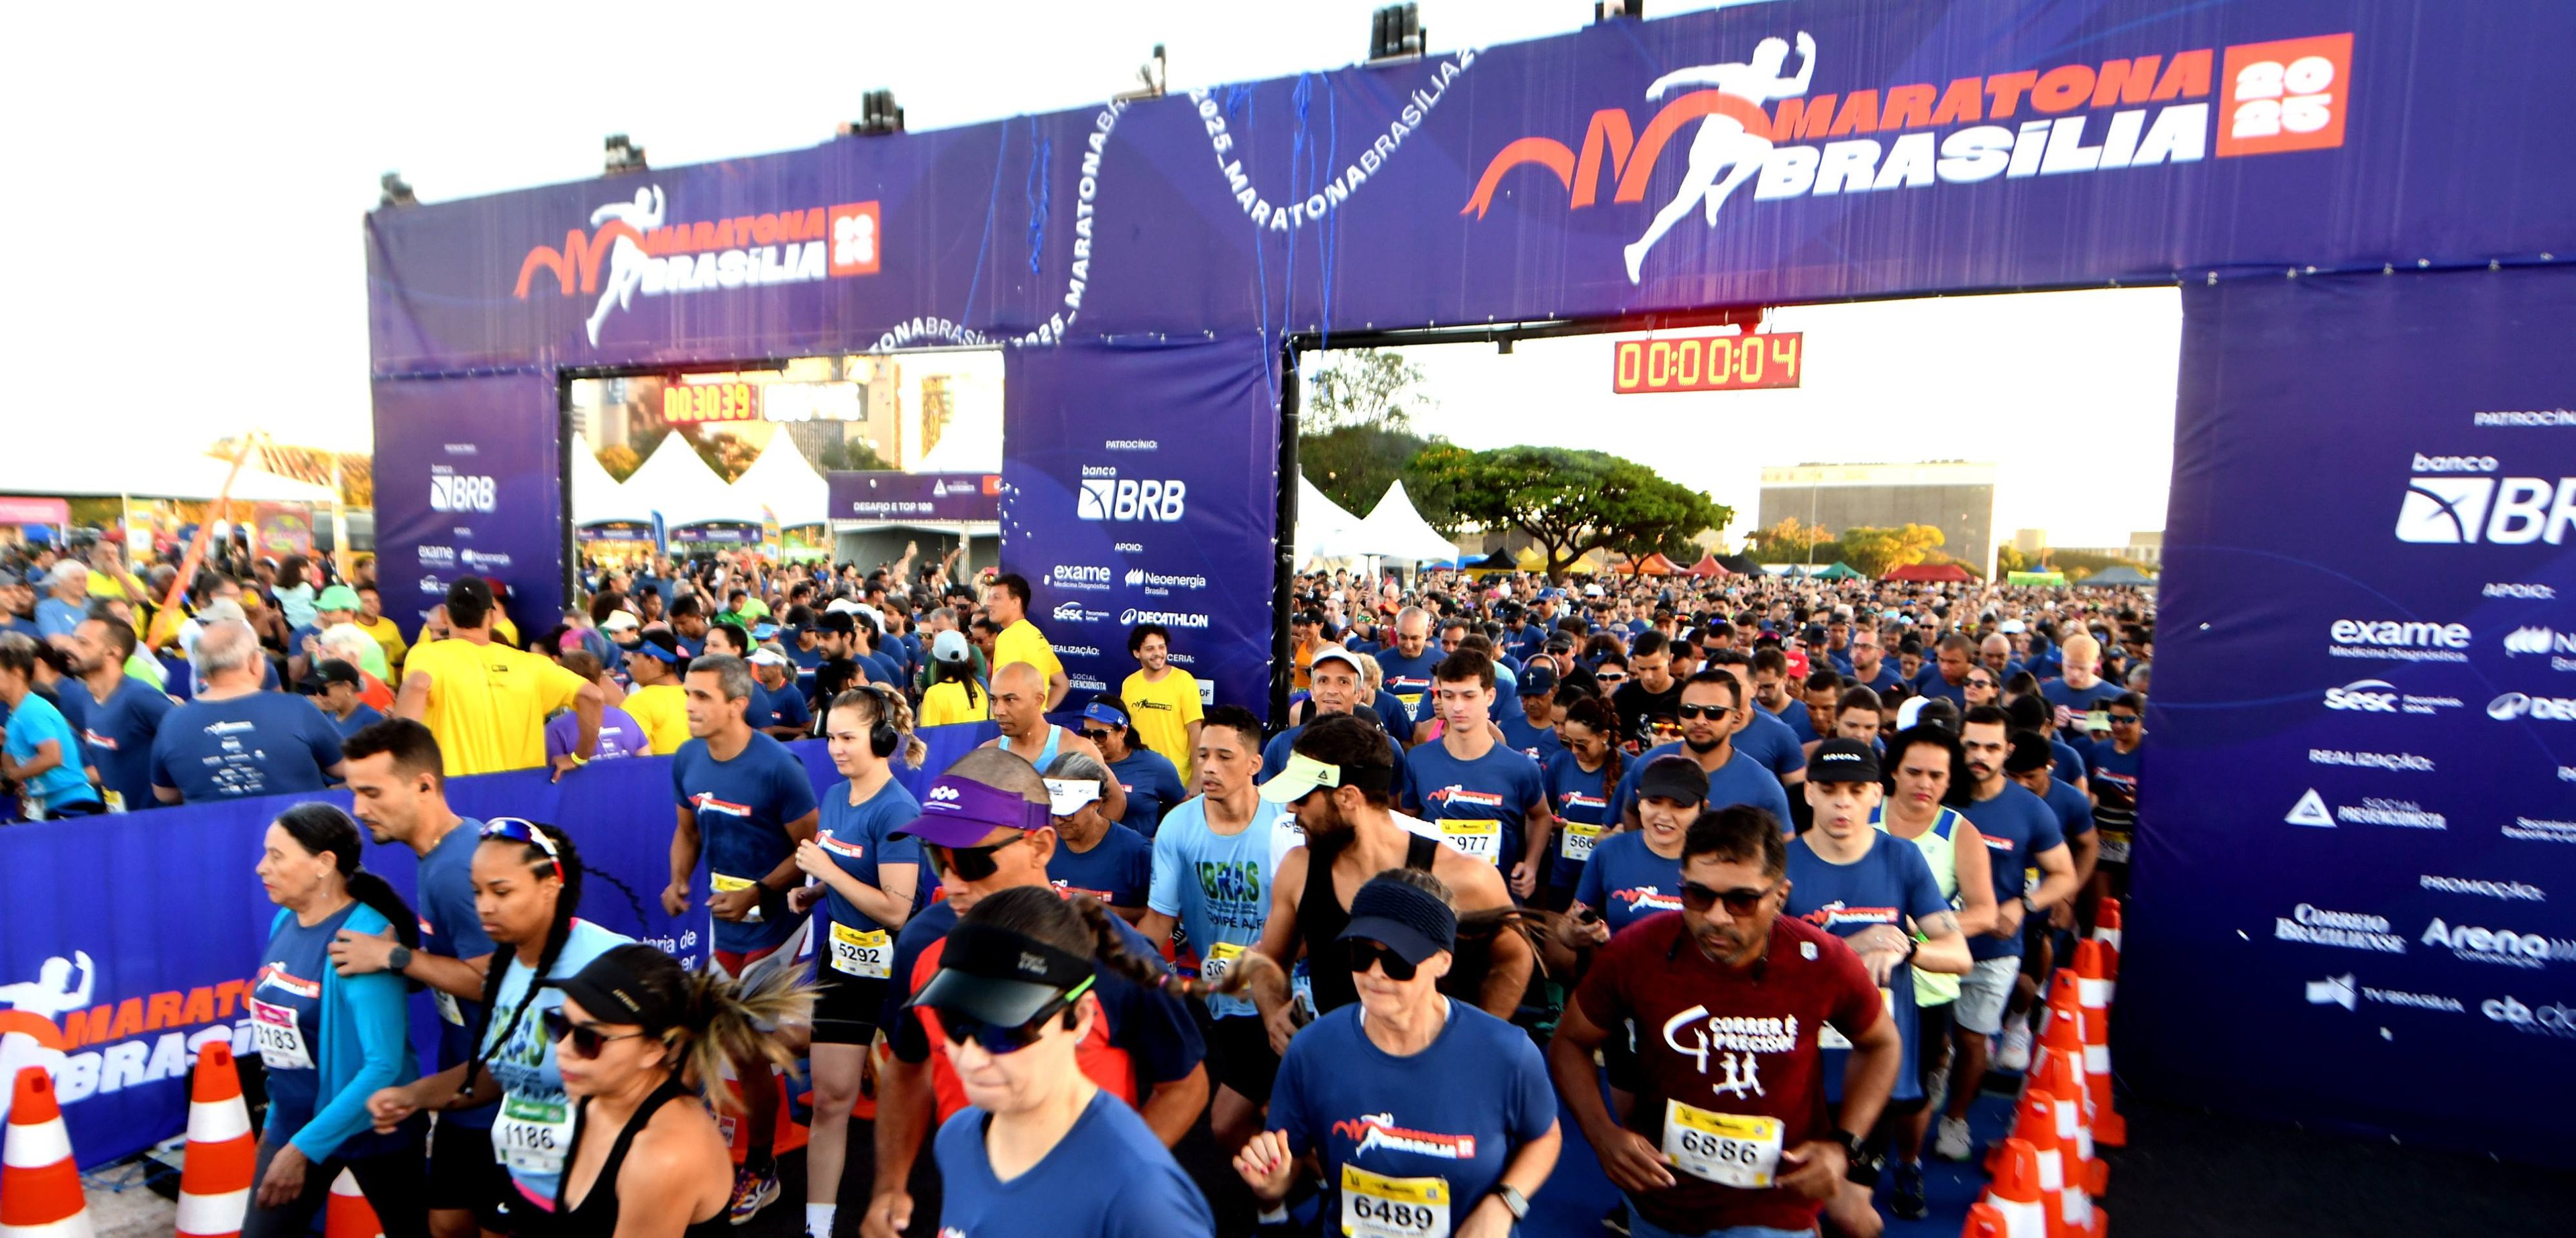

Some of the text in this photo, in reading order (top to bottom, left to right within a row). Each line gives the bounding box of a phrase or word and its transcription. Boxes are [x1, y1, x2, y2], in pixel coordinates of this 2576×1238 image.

[2235, 55, 2334, 98] 20
[1770, 48, 2212, 142] MARATONA
[2233, 93, 2332, 137] 25
[1754, 102, 2209, 203] BRASÍLIA
[645, 207, 825, 258] MARATONA
[641, 241, 826, 295] BRASÍLIA
[1617, 336, 1796, 387] 00:00:04
[1106, 439, 1158, 450] PATROCÍNIO:
[1082, 464, 1116, 475] banco
[2412, 451, 2500, 472] banco
[452, 475, 497, 512] BRB
[1114, 480, 1186, 522] BRB
[853, 502, 890, 512] DESAFIO
[898, 502, 916, 512] TOP
[917, 502, 933, 512] 100
[1114, 543, 1143, 552] APOIO:
[1054, 565, 1111, 581] exame
[1145, 572, 1206, 589] Neoenergia
[1138, 611, 1208, 628] DECATHLON
[2330, 618, 2472, 648] exame
[1167, 654, 1195, 663] CERIA:
[1069, 679, 1106, 691] EVENCIONISTA
[1448, 836, 1489, 851] 977
[1570, 836, 1596, 849] 566
[680, 929, 697, 950] de
[2420, 917, 2550, 960] Arena
[680, 954, 696, 972] er
[839, 942, 880, 964] 5292
[63, 977, 256, 1050] MARAT
[1709, 1016, 1784, 1036] CORRER
[56, 1018, 260, 1107] BRASÍ
[504, 1121, 555, 1150] 1186
[1681, 1129, 1758, 1165] 6886
[1354, 1194, 1434, 1230] 6489
